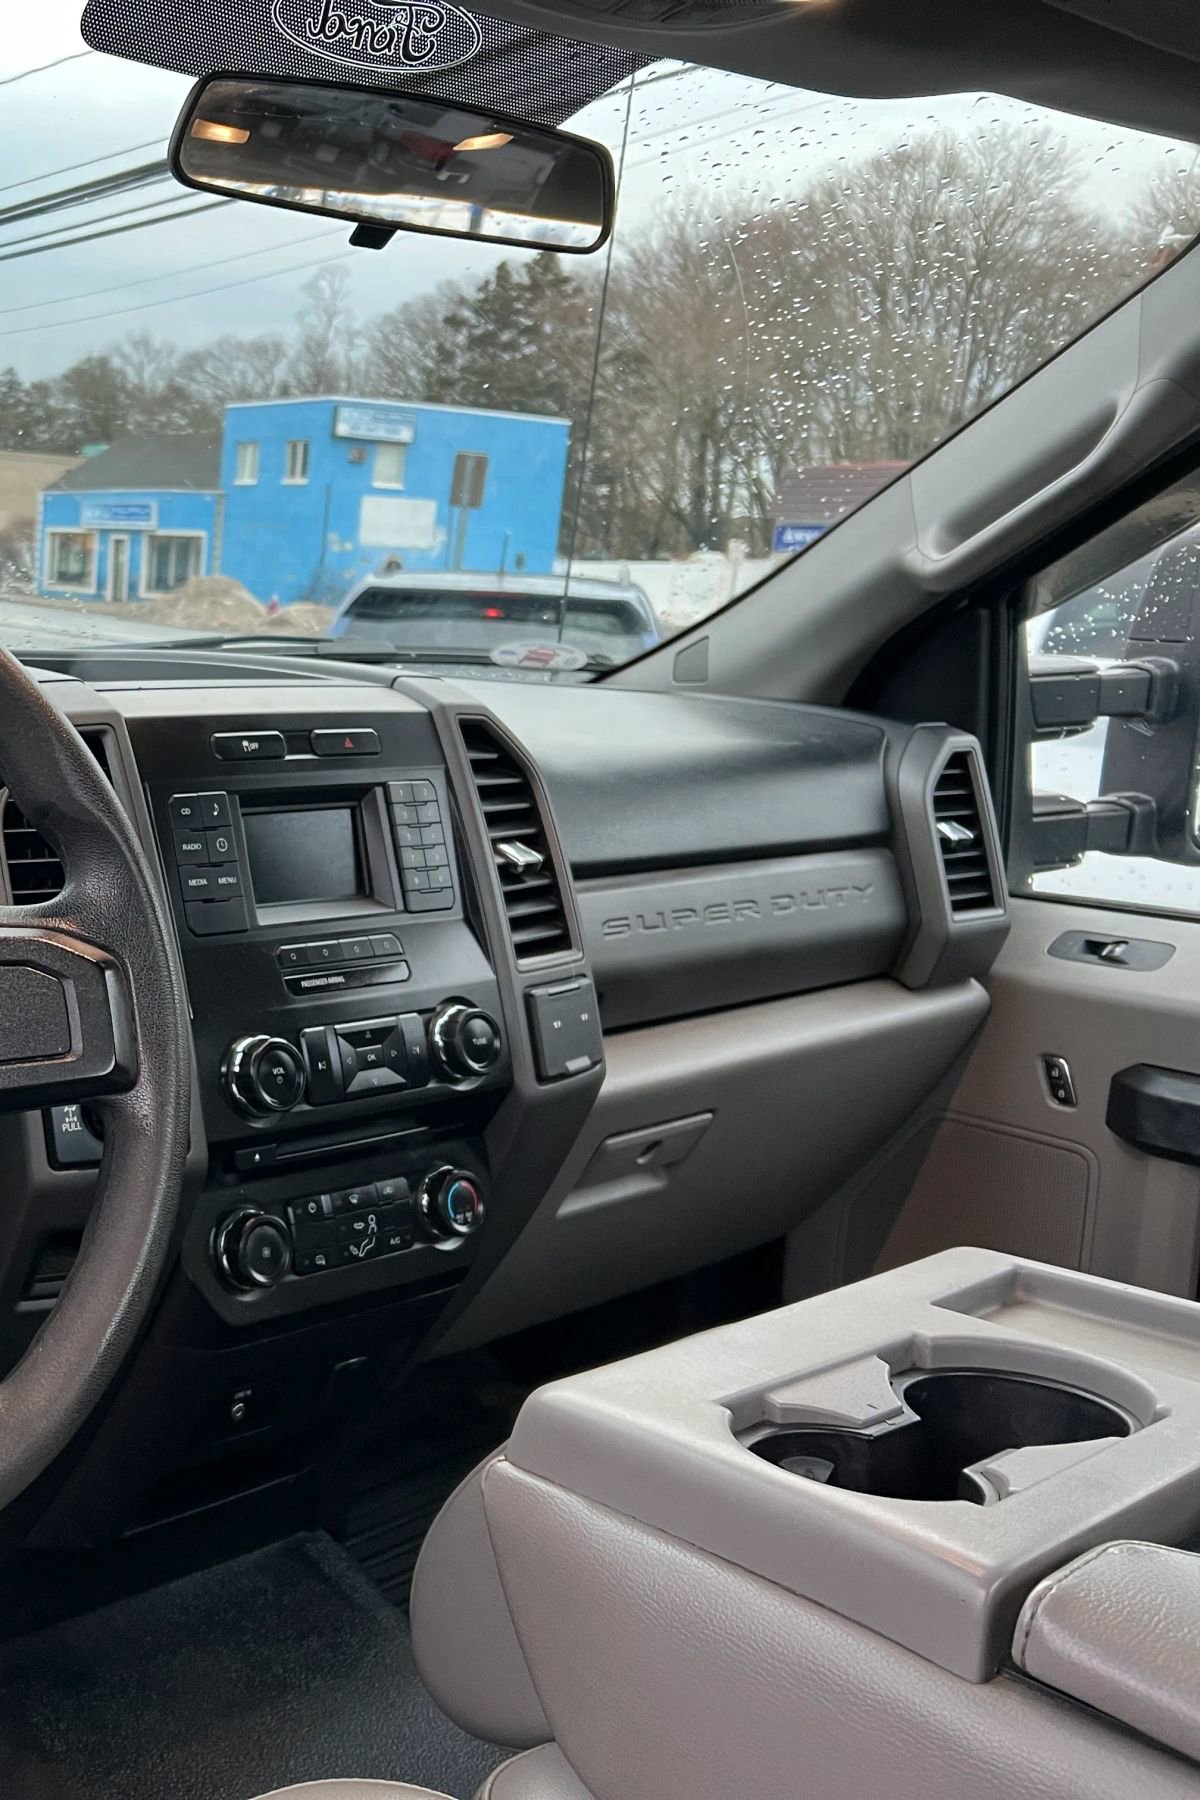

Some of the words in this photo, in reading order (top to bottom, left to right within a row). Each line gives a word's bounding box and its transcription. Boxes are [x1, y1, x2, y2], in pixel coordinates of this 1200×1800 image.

[188, 878, 208, 886] MEDIA
[218, 876, 236, 884] MENU
[602, 899, 761, 940] SUPER
[770, 883, 874, 915] DUTY
[473, 1037, 488, 1046] TUNE
[367, 1053, 377, 1061] OK
[272, 1067, 285, 1075] VOL
[62, 1121, 82, 1132] PULL
